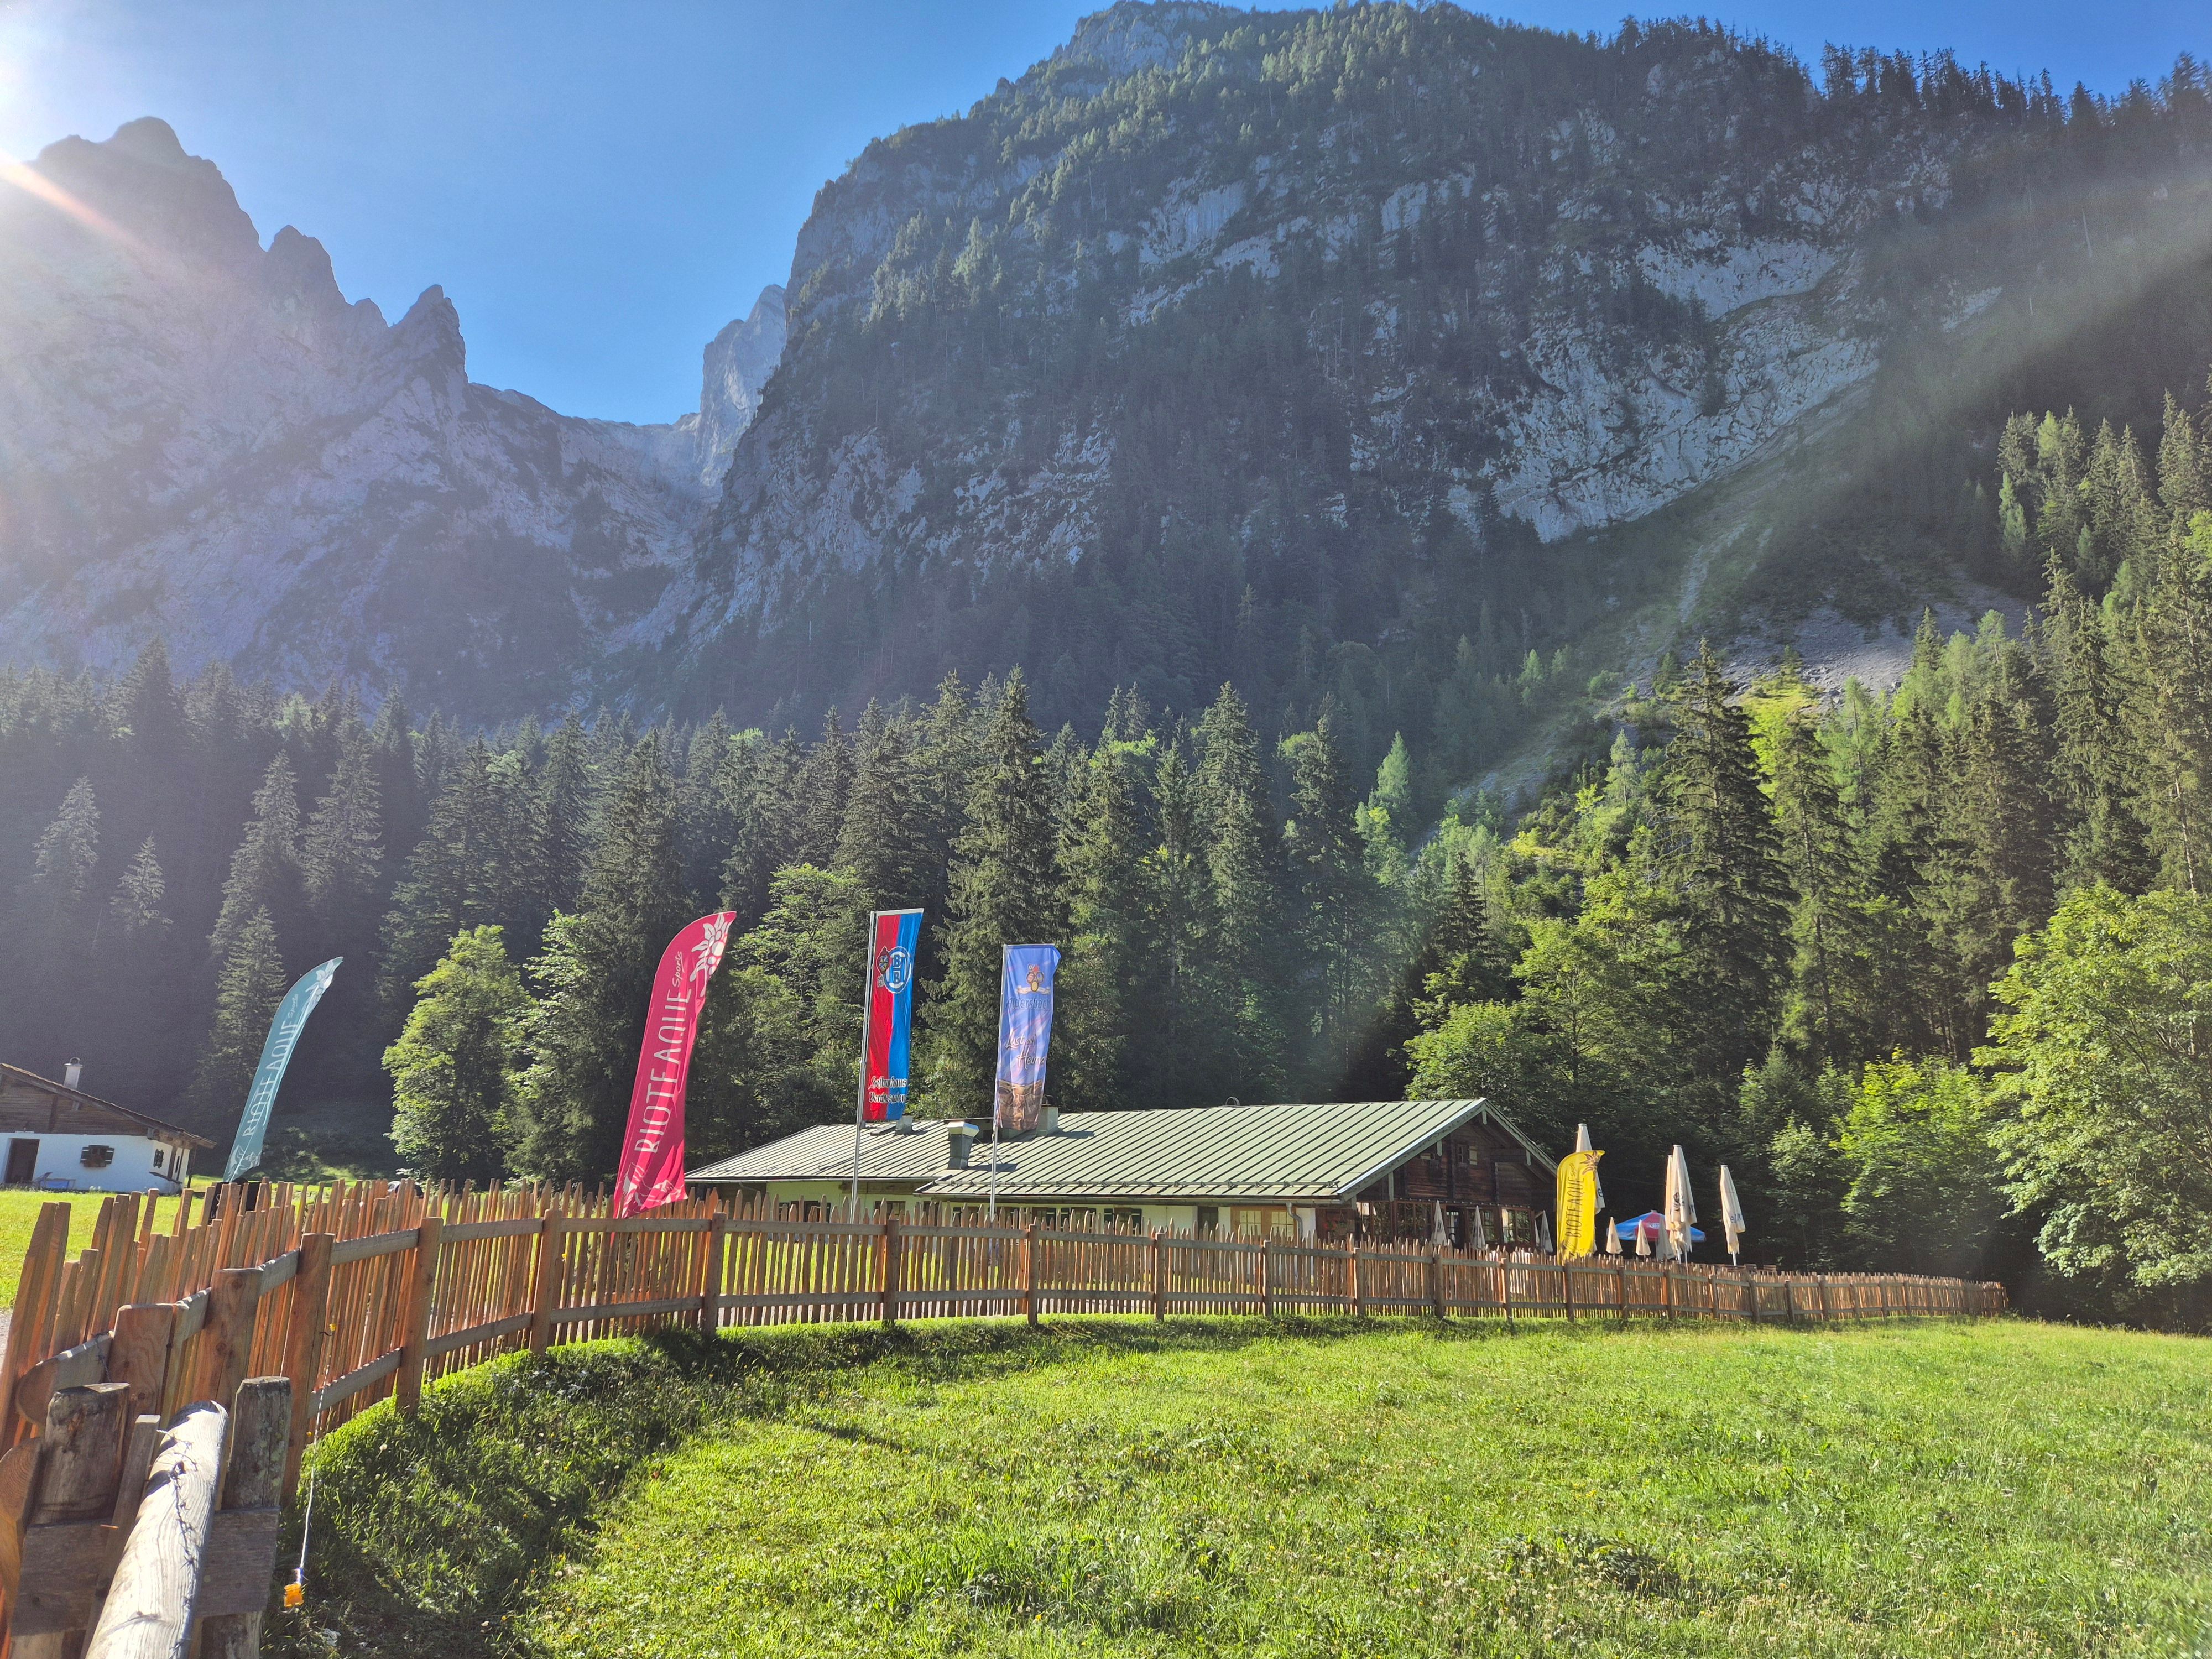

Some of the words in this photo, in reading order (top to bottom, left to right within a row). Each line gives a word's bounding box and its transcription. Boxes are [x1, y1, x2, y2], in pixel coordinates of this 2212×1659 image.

[672, 951, 685, 987] Sports
[1005, 1028, 1025, 1049] Lust
[1016, 1044, 1045, 1070] Heima
[242, 1020, 298, 1137] BIOTEAQUE
[634, 988, 692, 1154] BIOTEAQUE
[1565, 1177, 1585, 1238] BIOTEAQUE
